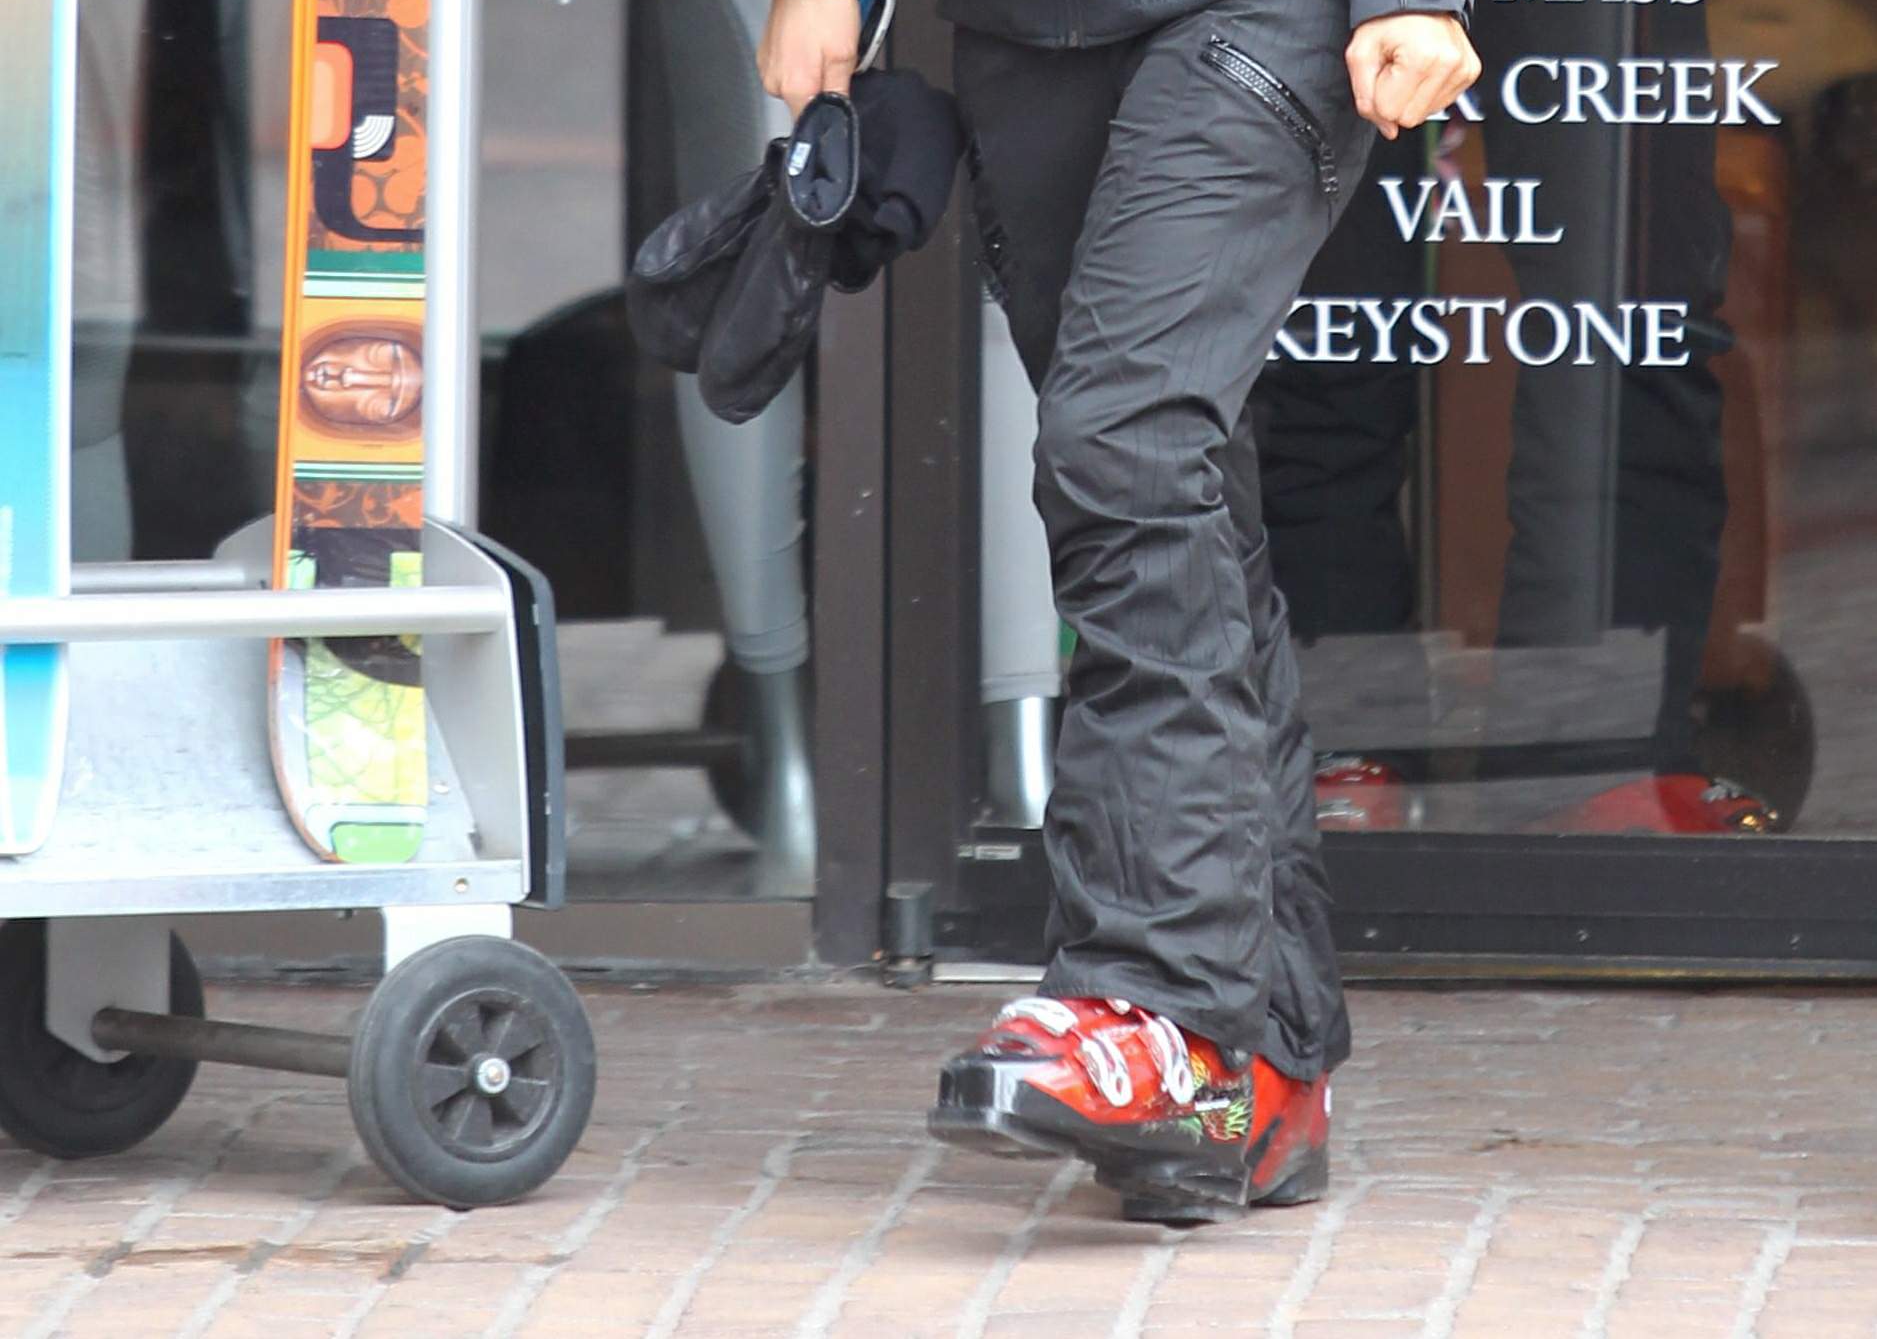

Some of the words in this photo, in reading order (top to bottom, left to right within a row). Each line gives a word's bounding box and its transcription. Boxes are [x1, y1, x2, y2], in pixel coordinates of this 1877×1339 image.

[1500, 58, 1782, 126] CREEK
[1377, 176, 1565, 244] VAIL
[1265, 298, 1691, 367] KEYSTONE
